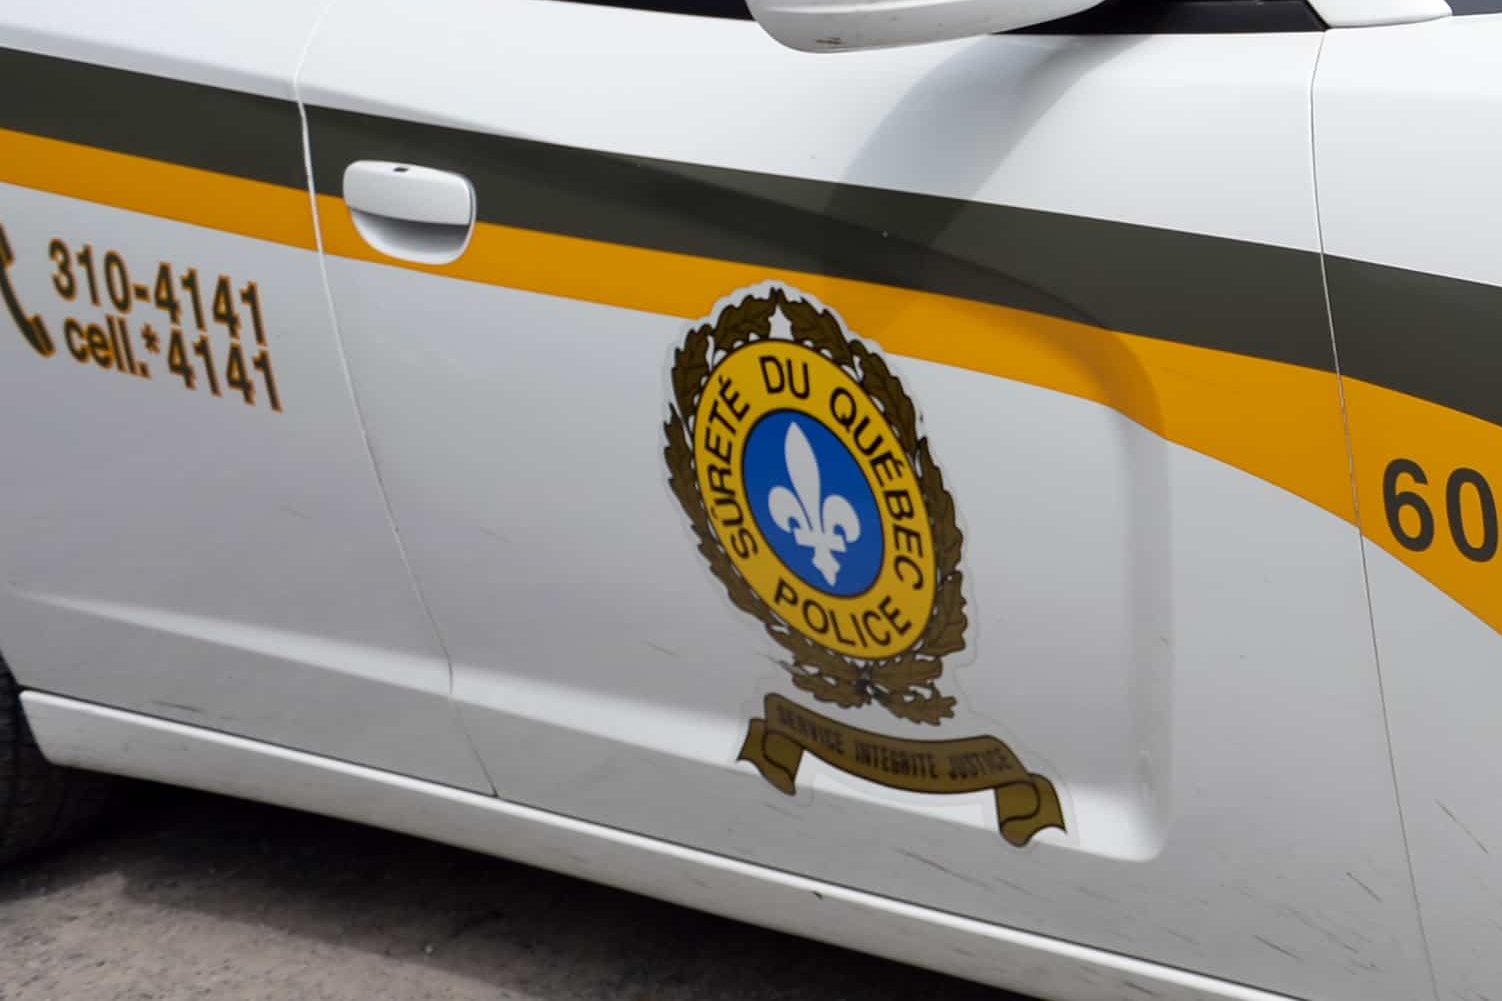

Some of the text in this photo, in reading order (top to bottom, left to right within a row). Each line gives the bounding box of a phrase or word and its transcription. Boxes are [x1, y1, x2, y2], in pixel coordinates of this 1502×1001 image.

[48, 237, 267, 348] 310-4141
[704, 355, 925, 592] SÛRETÉ DU QUÉBEC
[774, 579, 913, 649] POLICE
